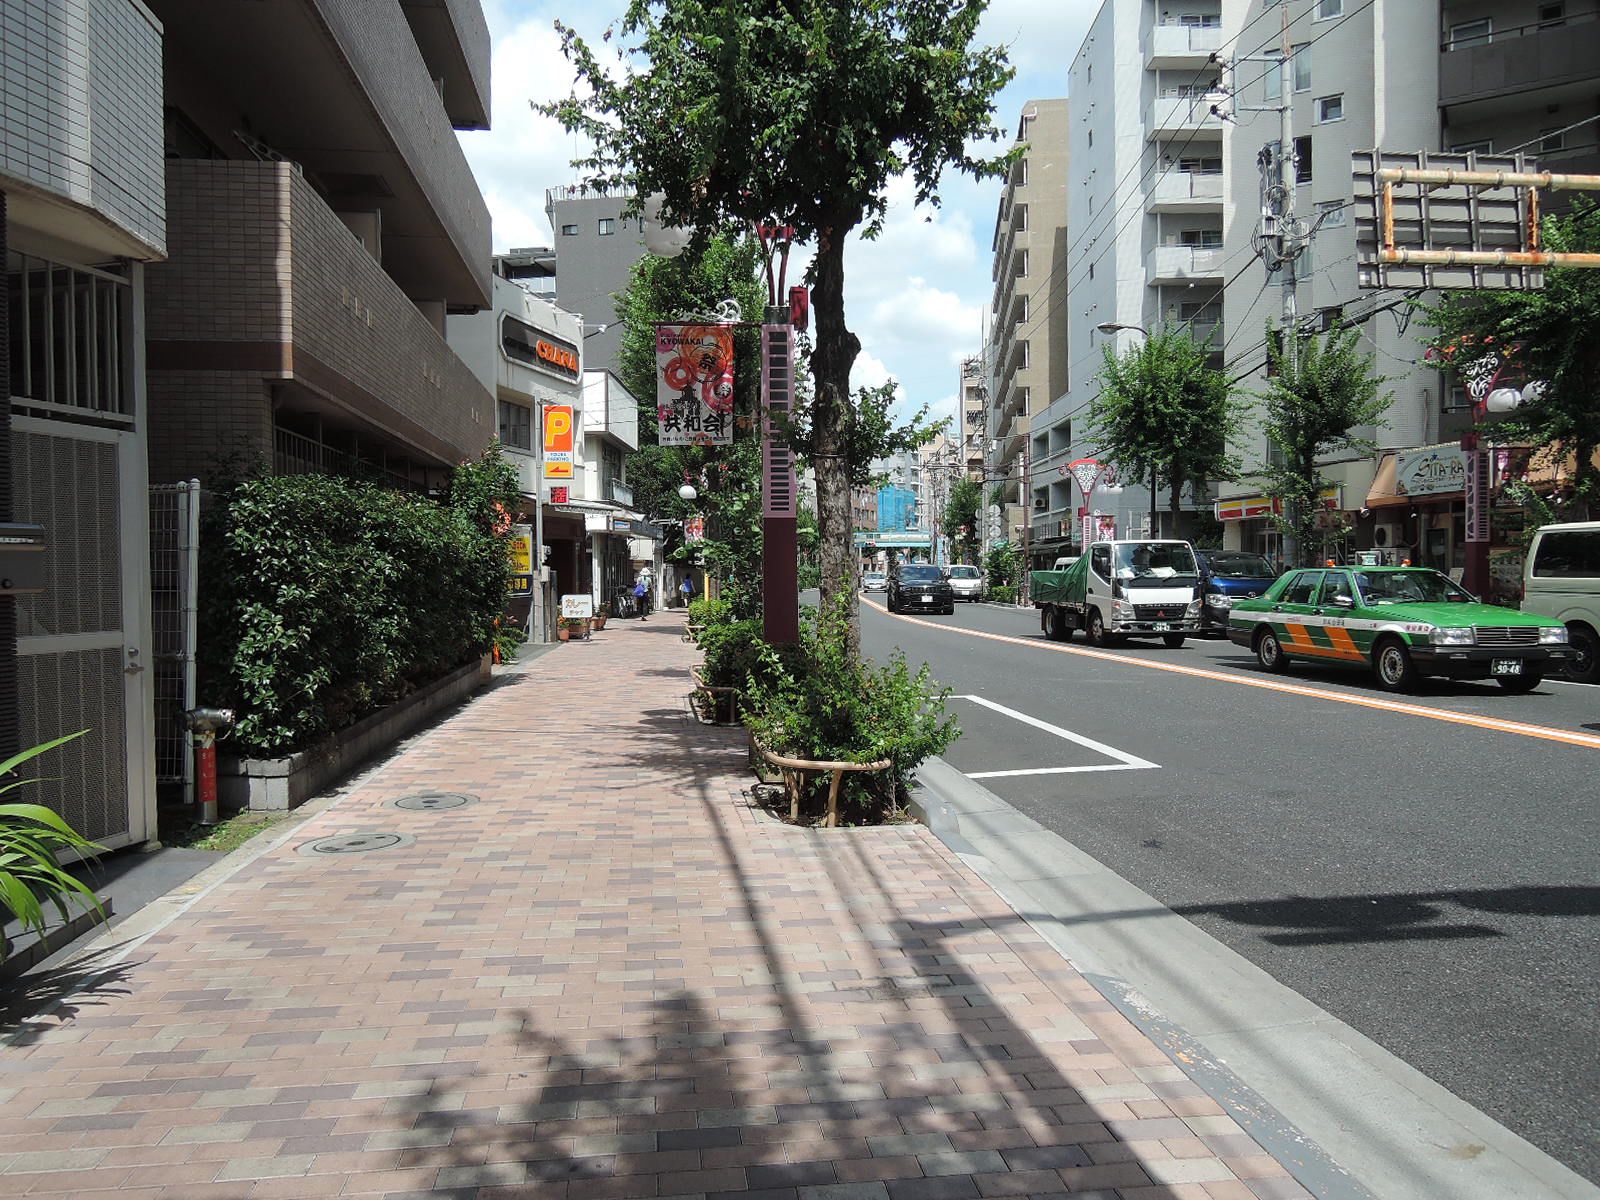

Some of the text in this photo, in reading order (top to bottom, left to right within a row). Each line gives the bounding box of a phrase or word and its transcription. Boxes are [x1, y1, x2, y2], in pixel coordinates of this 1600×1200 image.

[545, 411, 571, 447] P
[664, 413, 720, 434] 共和会
